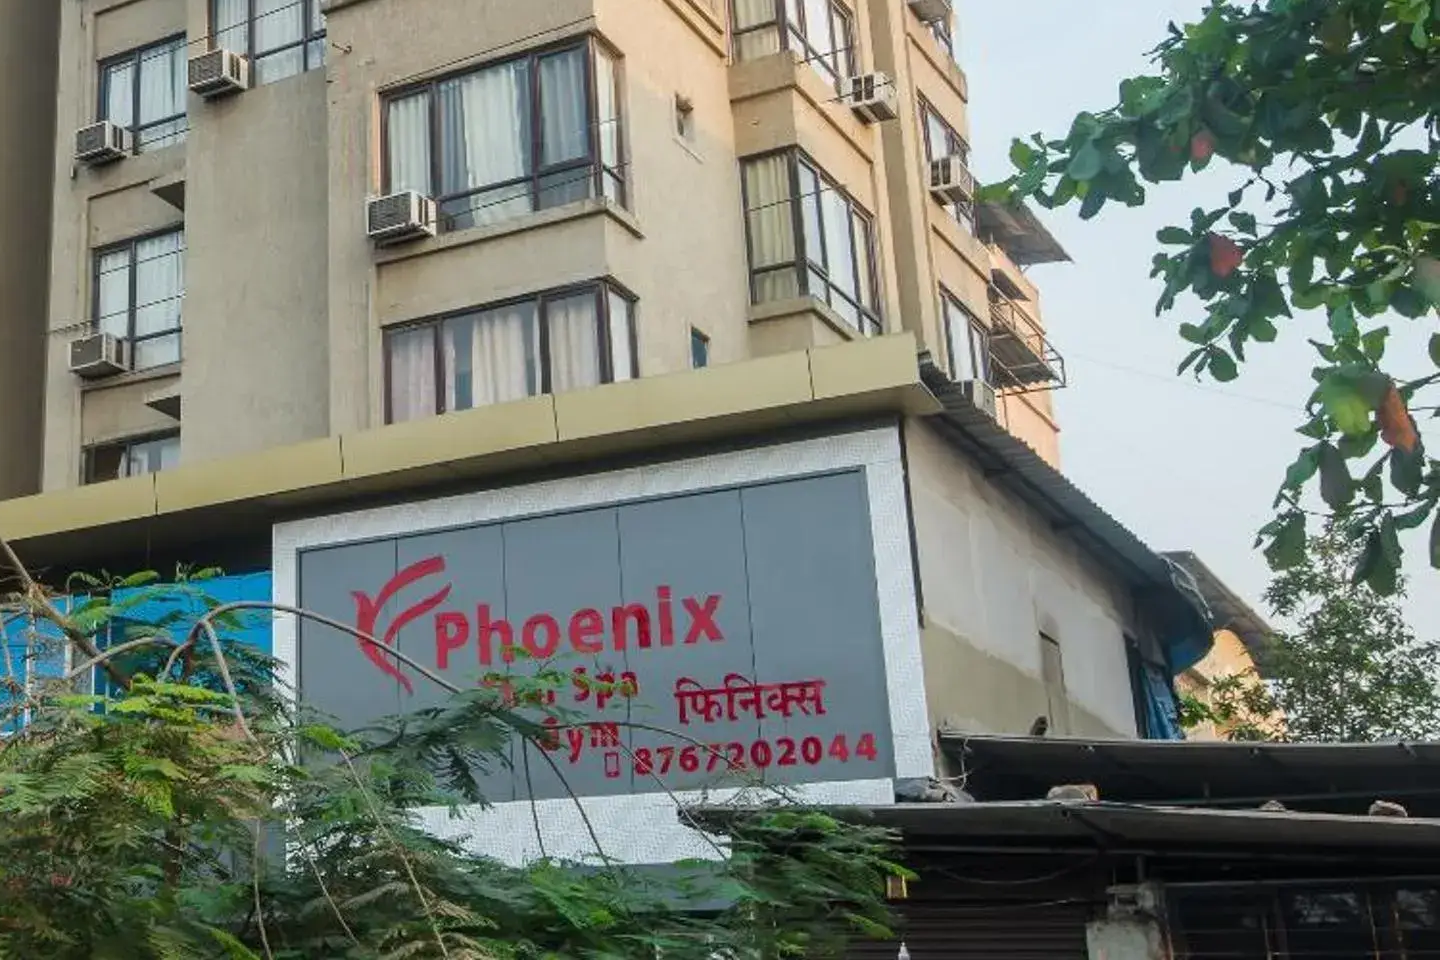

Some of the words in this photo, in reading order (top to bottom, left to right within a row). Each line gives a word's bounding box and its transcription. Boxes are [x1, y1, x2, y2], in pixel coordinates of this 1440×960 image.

[434, 585, 724, 670] Phoenix
[674, 672, 827, 724] फिनिक्स
[633, 732, 878, 776] 8767202044
